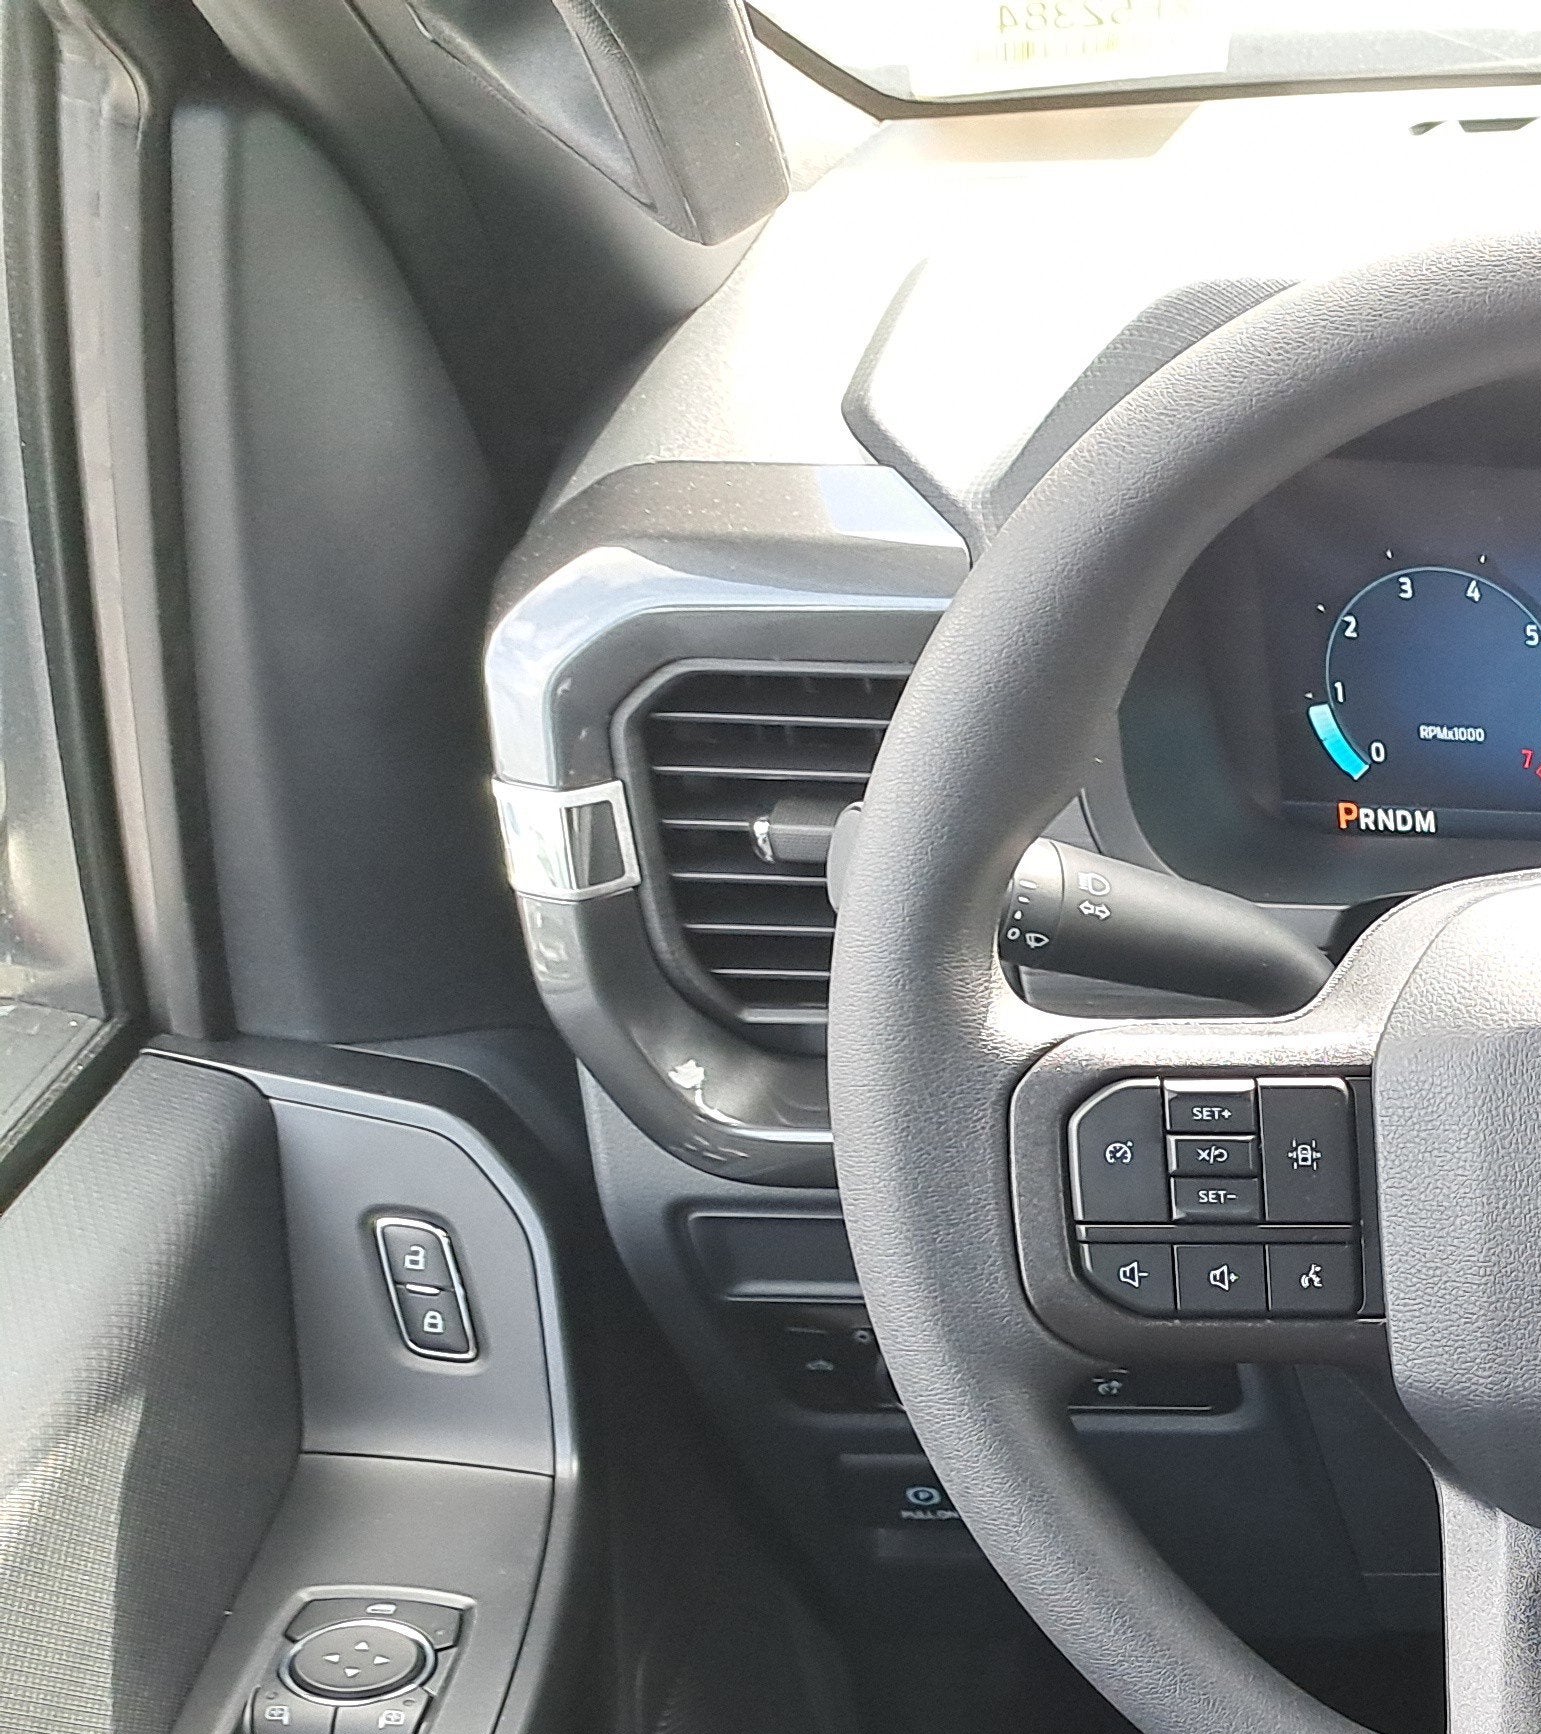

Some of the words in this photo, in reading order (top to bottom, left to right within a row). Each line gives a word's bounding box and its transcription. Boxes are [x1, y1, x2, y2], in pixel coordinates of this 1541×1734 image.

[1398, 576, 1413, 600] 3
[1466, 580, 1481, 602] 4
[1341, 615, 1358, 638] 2
[1525, 625, 1540, 646] 5
[1334, 681, 1344, 703] 1
[1370, 741, 1386, 763] 0
[1521, 749, 1534, 770] 7
[1192, 1106, 1232, 1120] SET+
